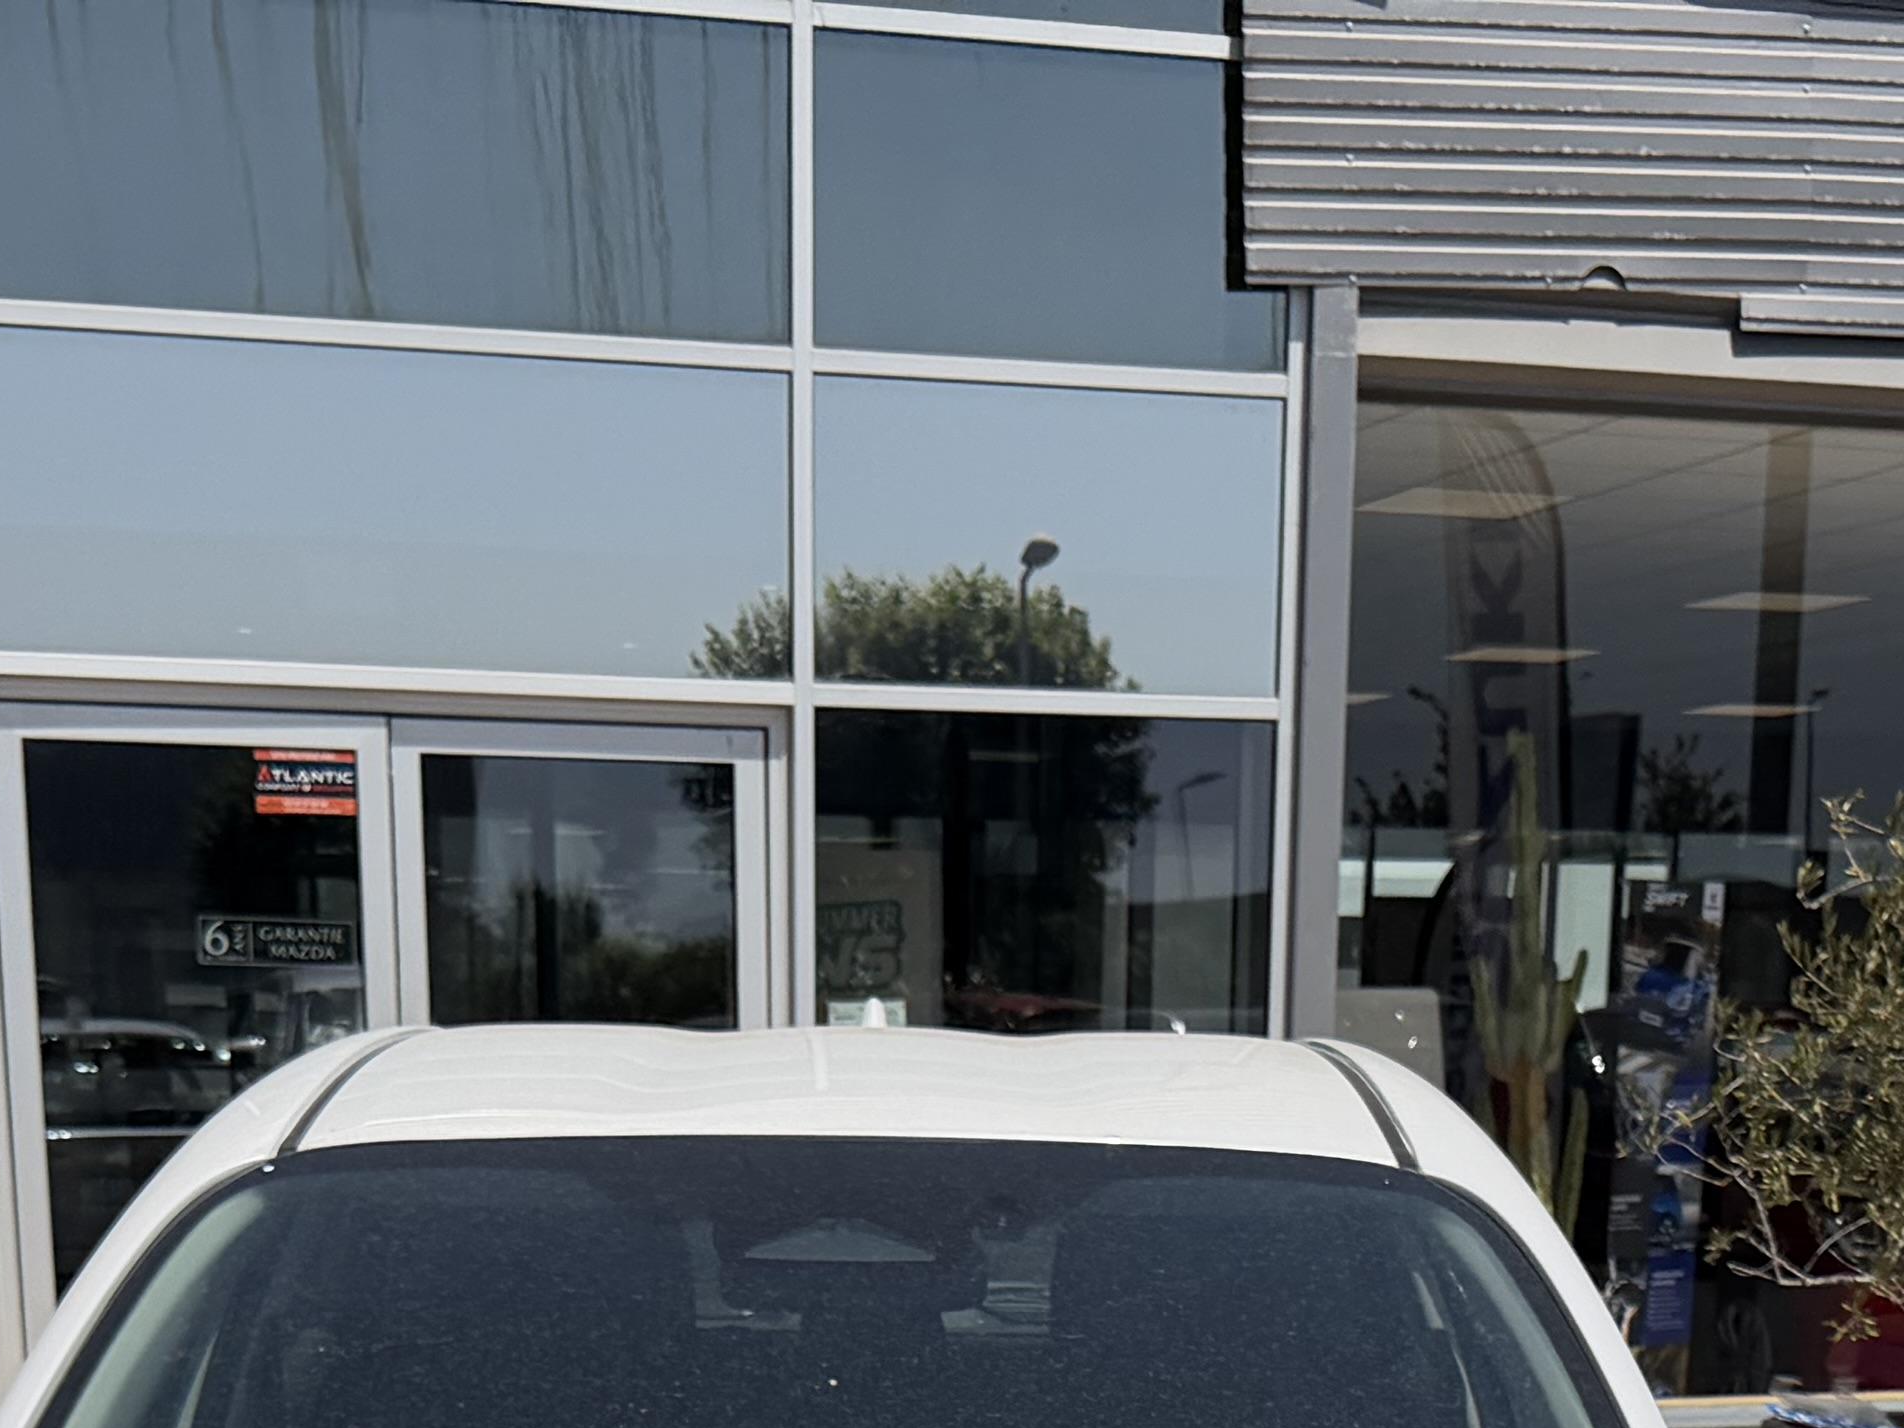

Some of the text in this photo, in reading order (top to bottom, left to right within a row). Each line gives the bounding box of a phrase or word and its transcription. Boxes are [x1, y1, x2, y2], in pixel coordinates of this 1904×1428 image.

[258, 764, 354, 784] ATLANTIC
[204, 920, 230, 956] 6
[259, 927, 344, 944] GARANTIE
[270, 944, 337, 961] MAZDA
